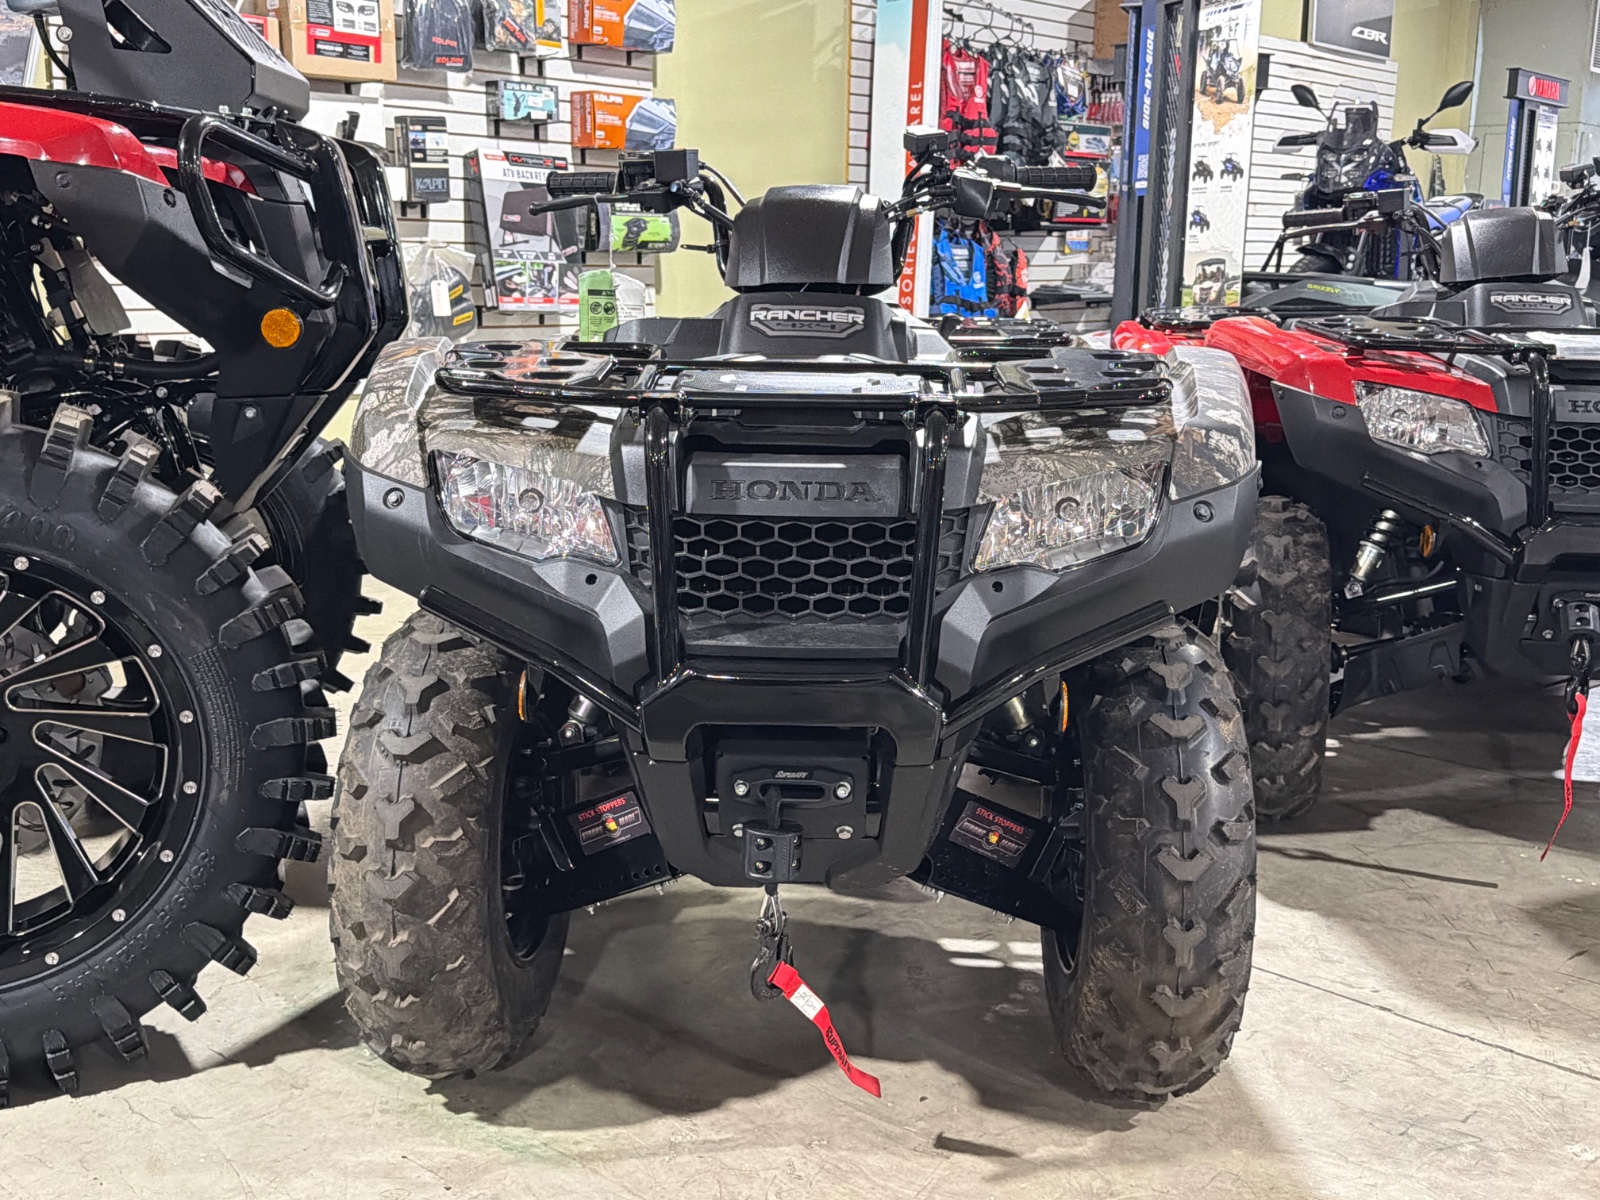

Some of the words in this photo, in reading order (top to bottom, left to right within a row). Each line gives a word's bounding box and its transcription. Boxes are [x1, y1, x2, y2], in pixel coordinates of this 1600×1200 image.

[432, 37, 457, 47] KOLPIN
[1352, 26, 1388, 45] CBR
[1142, 29, 1155, 130] SIDE-BY-SIDE
[1535, 78, 1560, 100] YAMAHA
[594, 93, 624, 104] KOLPIN
[503, 168, 515, 178] ATV
[516, 170, 547, 181] BACKRES
[415, 177, 447, 191] KOLPIN
[1306, 283, 1341, 294] GRIZZLY
[1490, 294, 1572, 305] RANCHER
[750, 310, 865, 324] RANCHER
[710, 479, 882, 502] HONDA
[578, 810, 595, 821] STICK
[596, 797, 626, 813] STOPPERS
[976, 807, 994, 820] STICK
[994, 816, 1025, 834] STOPPERS
